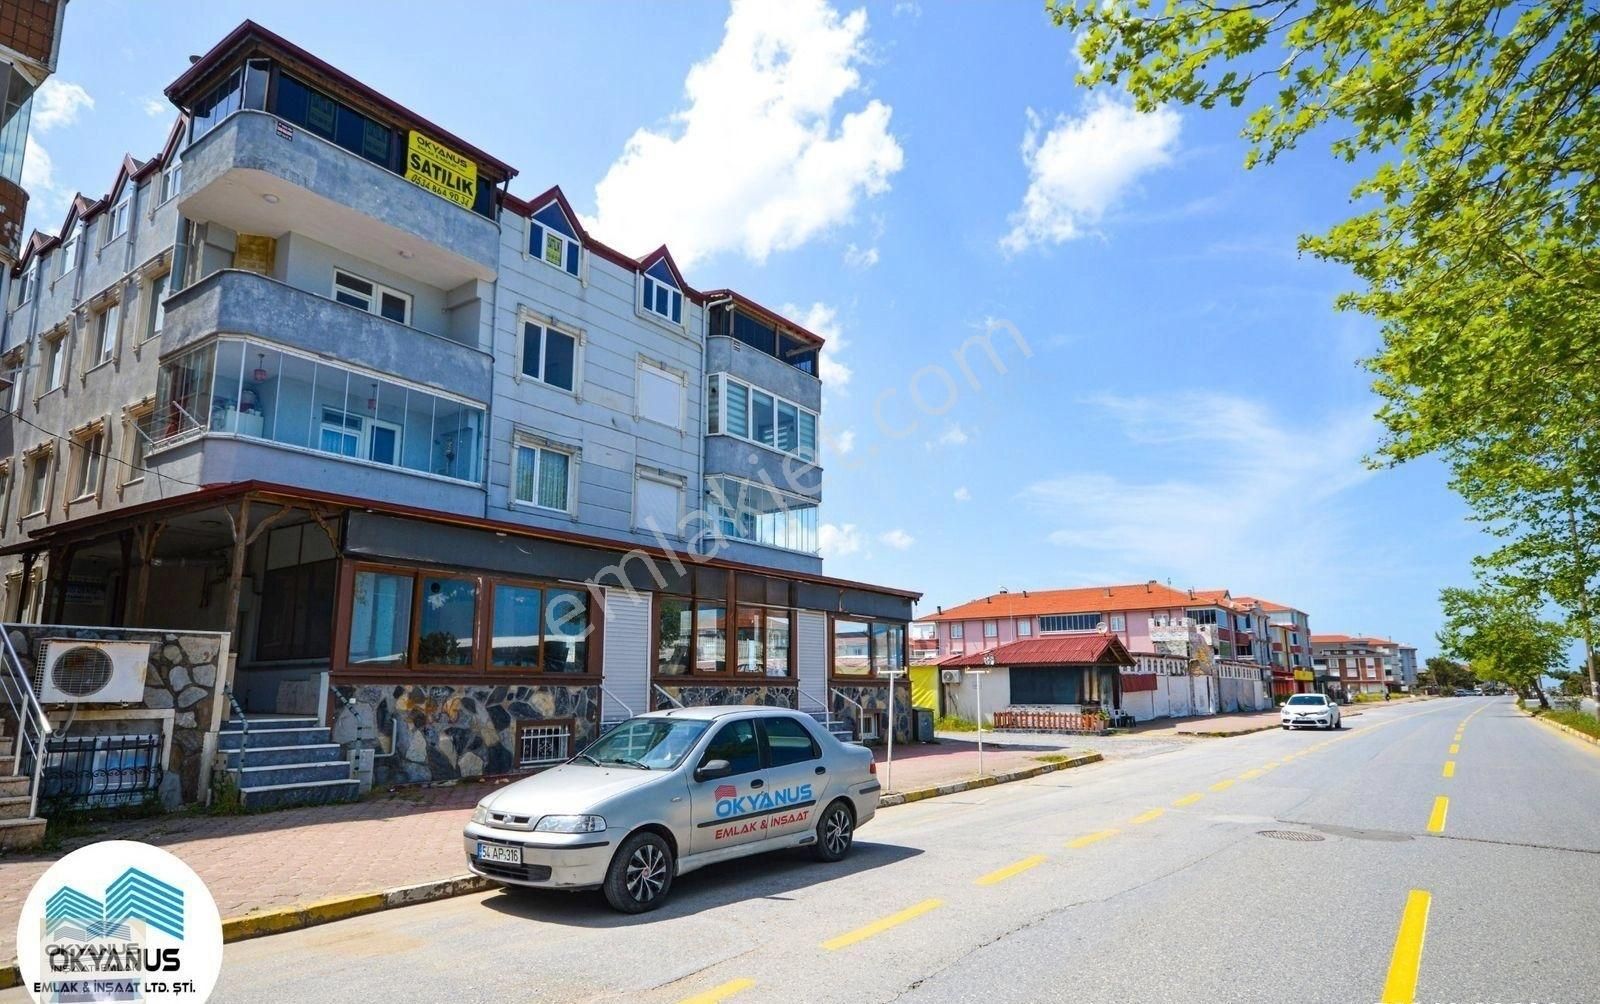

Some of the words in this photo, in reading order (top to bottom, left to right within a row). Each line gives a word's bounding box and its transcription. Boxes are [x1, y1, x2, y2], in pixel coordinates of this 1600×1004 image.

[416, 136, 468, 169] OKYANUS
[410, 153, 473, 197] SATILIK
[715, 784, 813, 818] OKYANUS
[715, 822, 757, 840] EMLAK
[760, 819, 768, 830] &
[482, 846, 491, 858] 54
[493, 847, 504, 858] AP
[506, 849, 519, 862] 316
